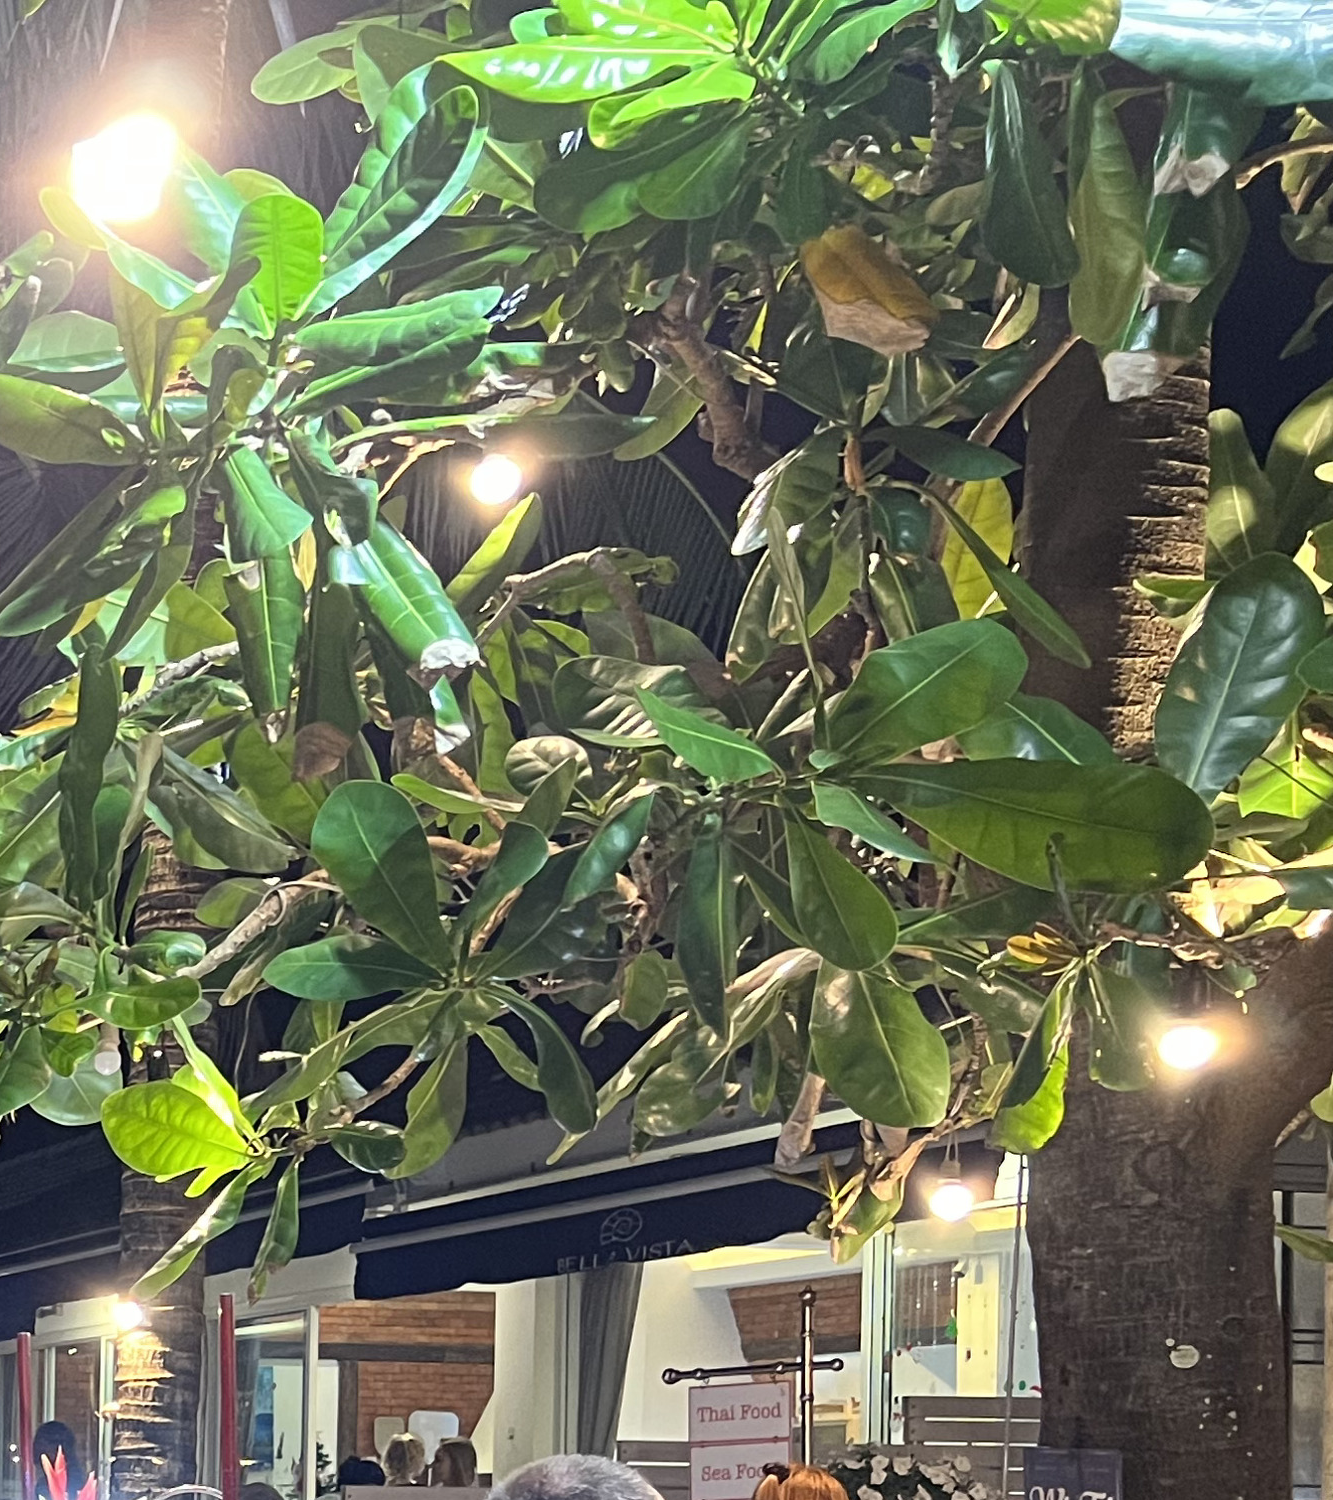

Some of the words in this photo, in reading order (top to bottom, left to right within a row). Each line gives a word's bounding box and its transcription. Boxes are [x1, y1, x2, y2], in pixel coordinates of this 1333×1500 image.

[625, 1239, 695, 1261] VISTA
[697, 1405, 735, 1423] Thai
[740, 1402, 782, 1420] Food
[701, 1465, 732, 1482] Sea
[735, 1464, 764, 1481] Foo
